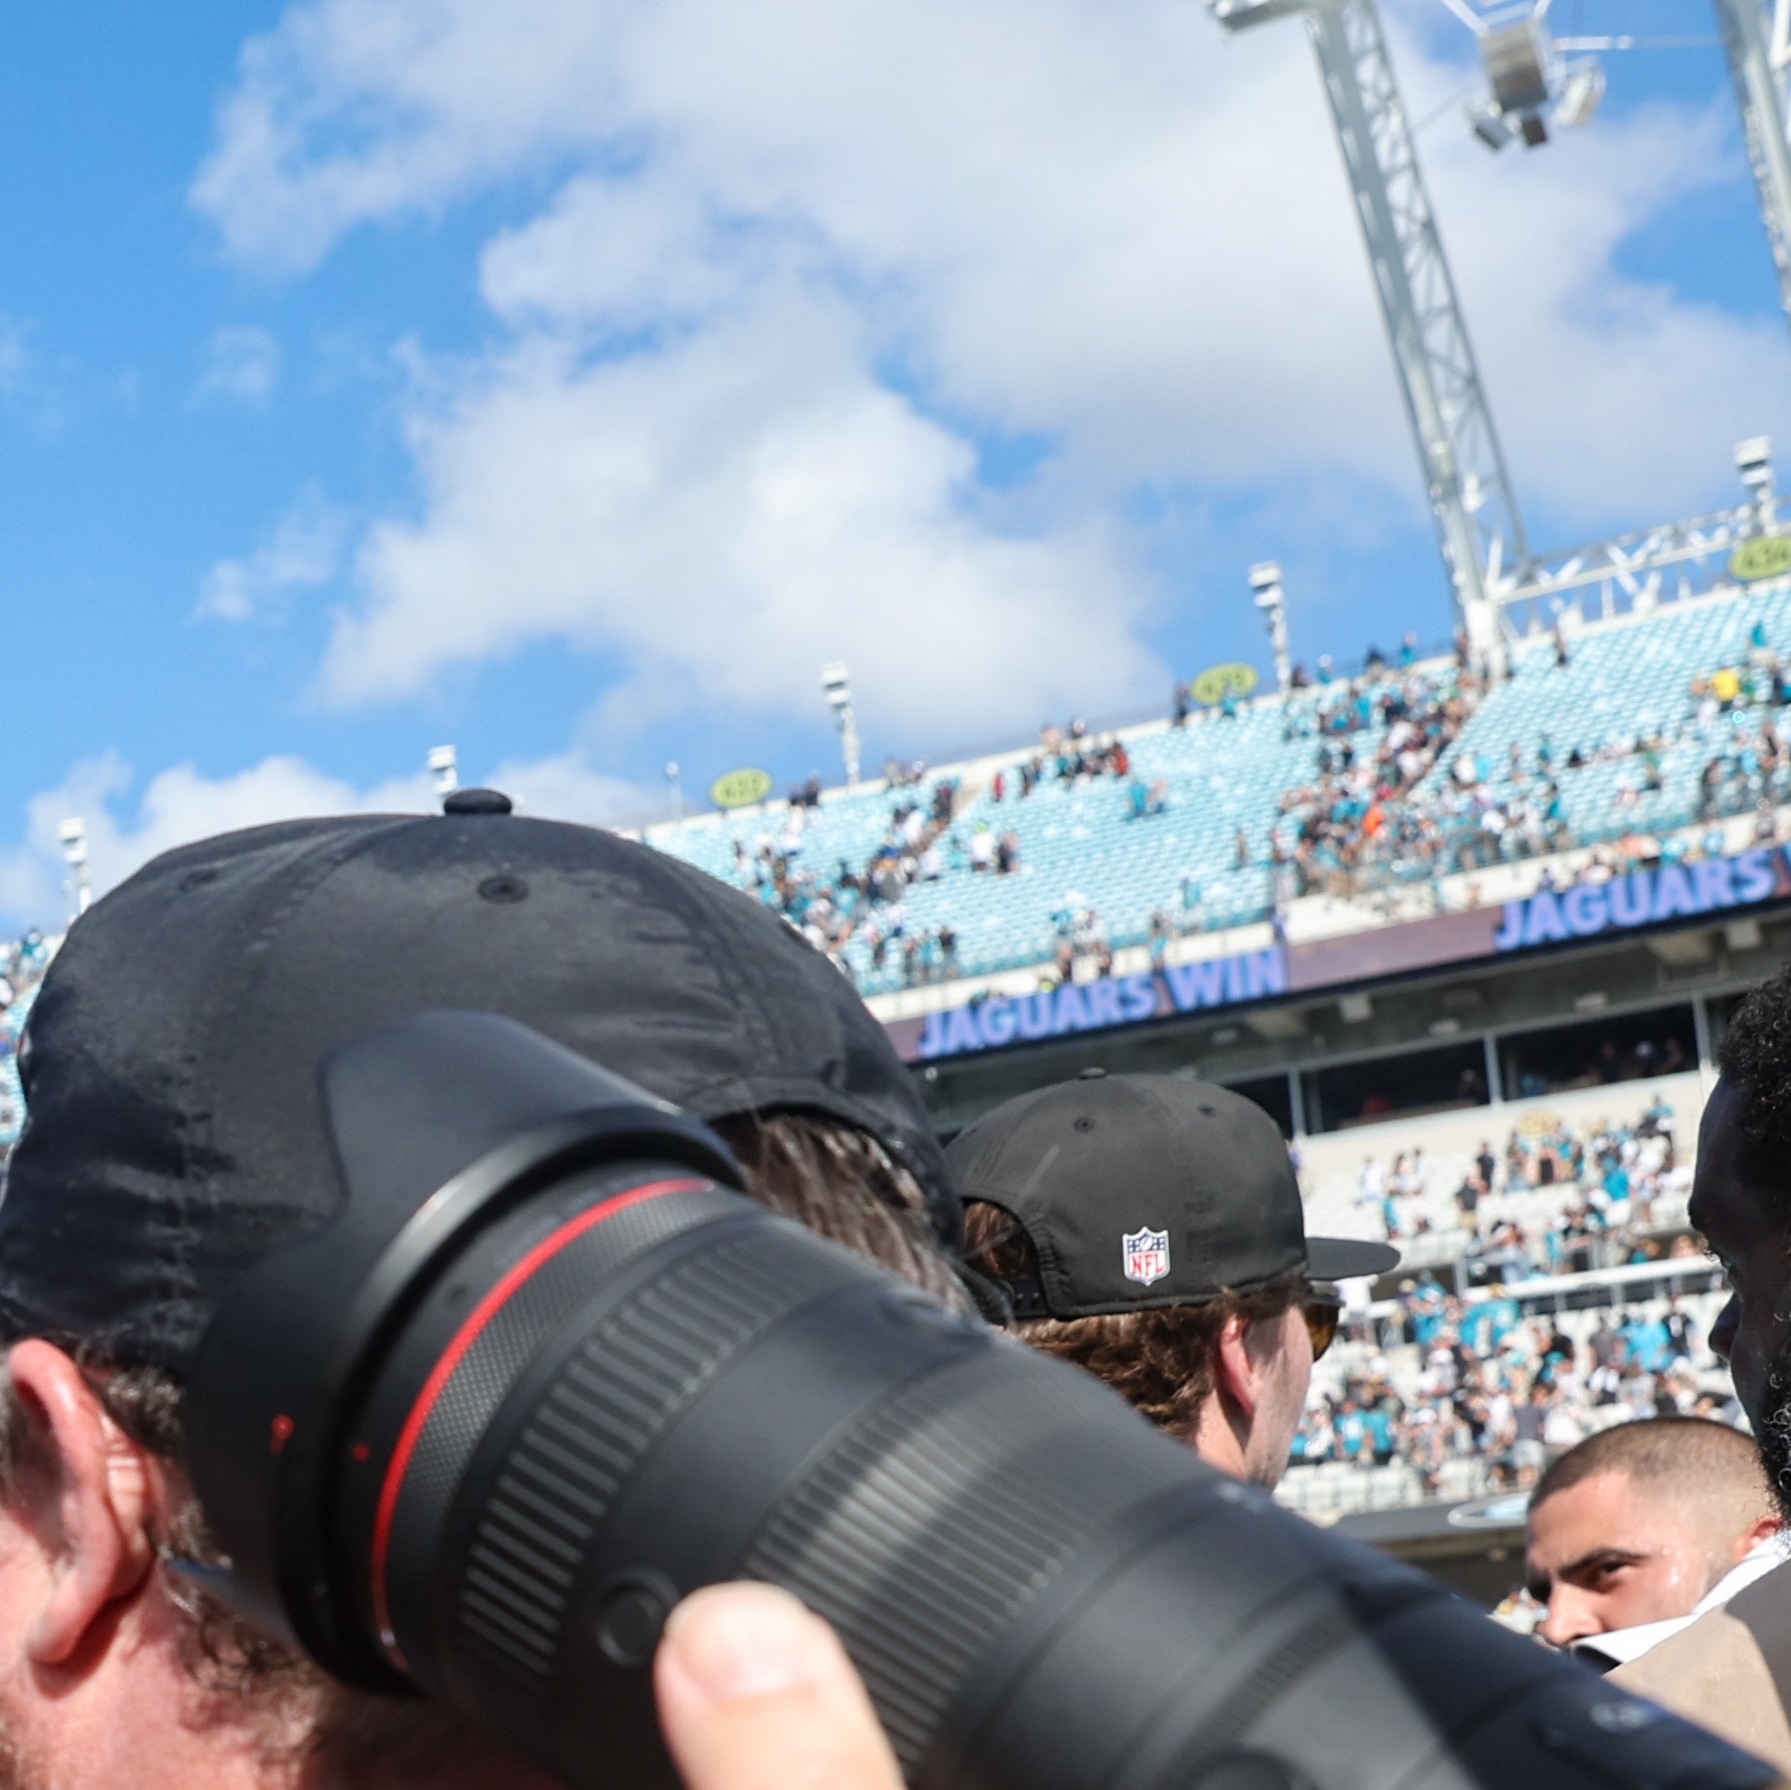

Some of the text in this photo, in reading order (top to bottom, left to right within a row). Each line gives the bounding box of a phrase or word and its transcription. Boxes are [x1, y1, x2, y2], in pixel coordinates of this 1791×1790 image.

[1495, 847, 1776, 952] JAGUARS
[918, 946, 1287, 1060] JAGUARS WIN
[1132, 1252, 1166, 1277] NFL
